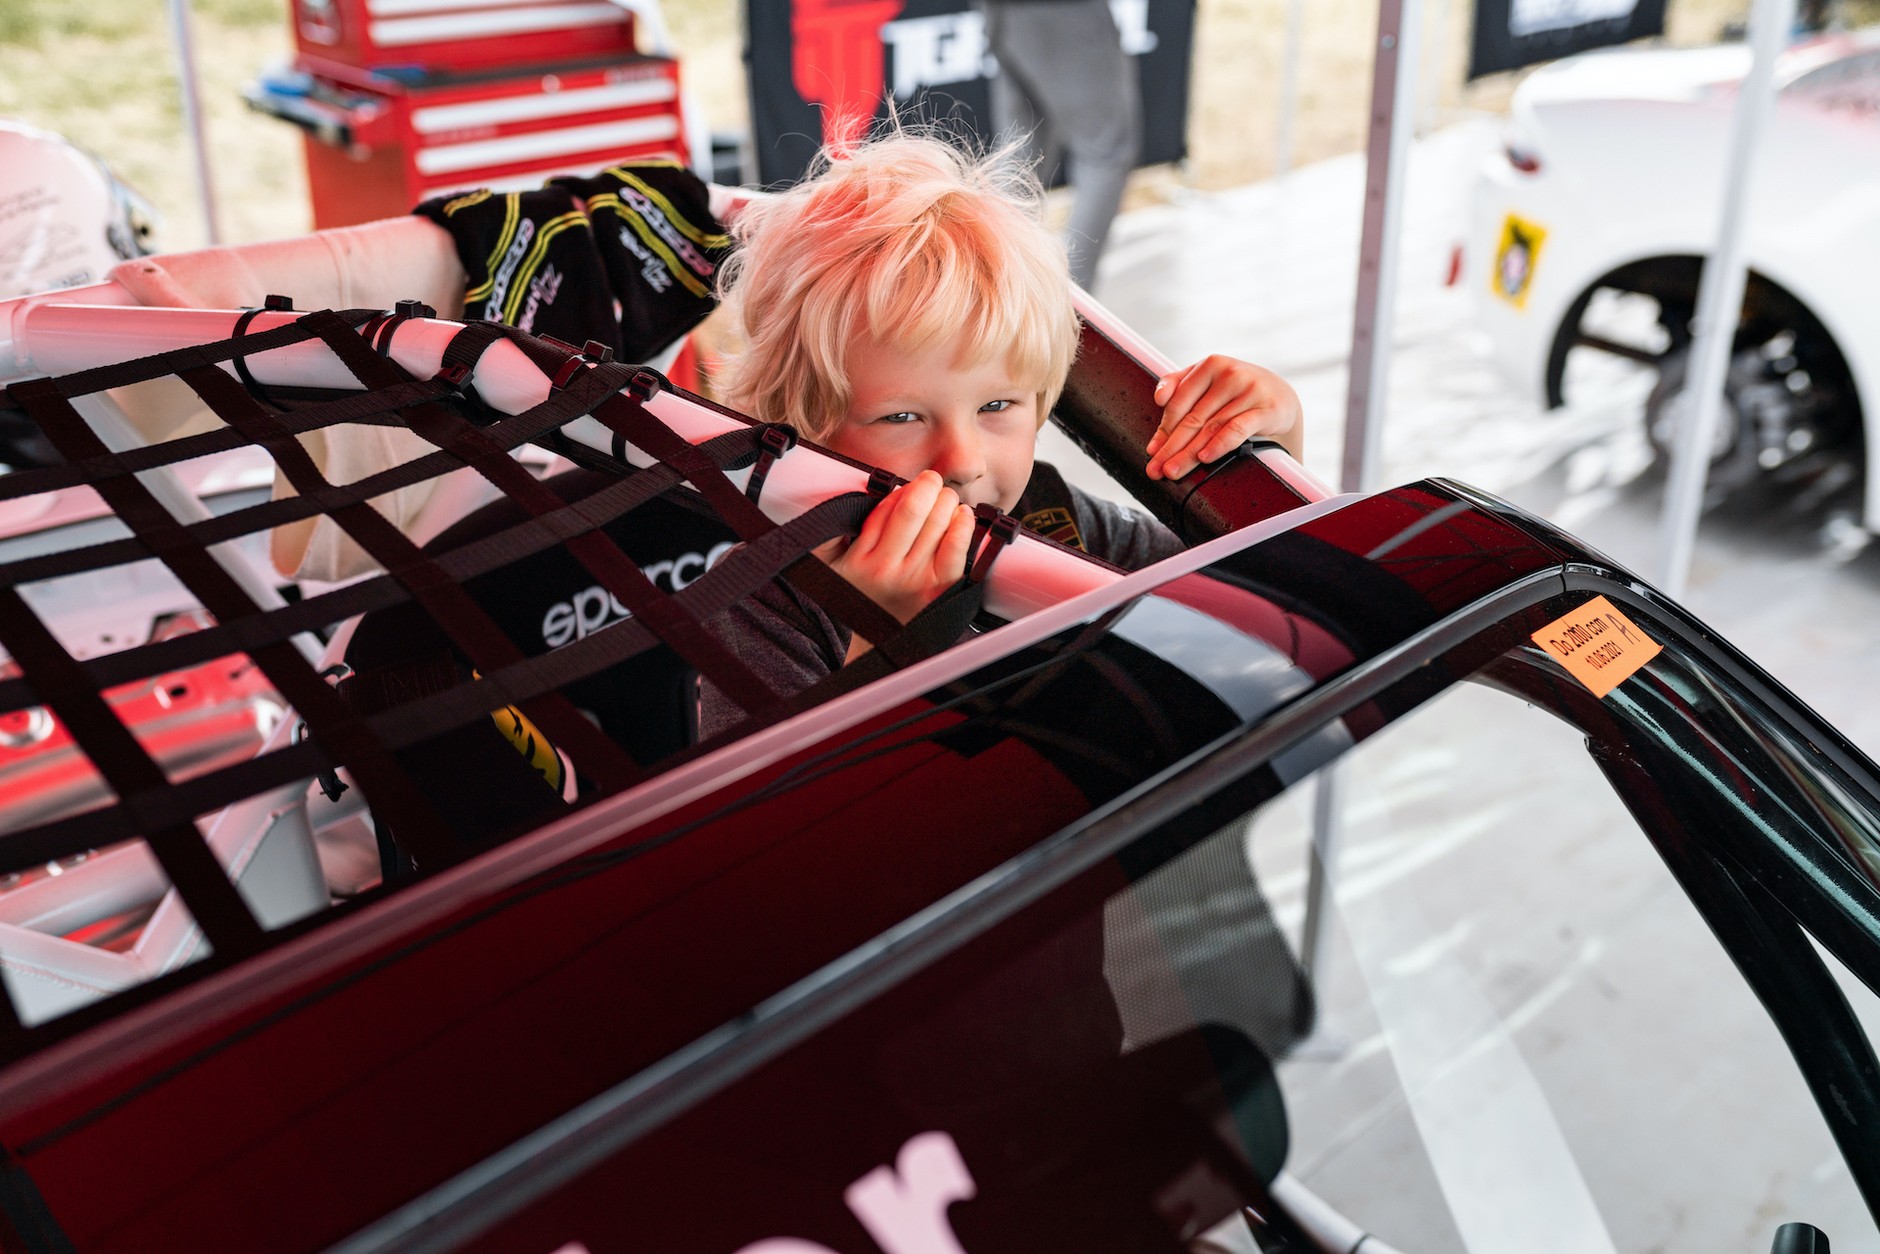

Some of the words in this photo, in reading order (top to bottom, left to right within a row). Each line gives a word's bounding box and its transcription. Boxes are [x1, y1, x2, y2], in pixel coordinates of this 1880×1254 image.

[1549, 638, 1575, 657] Do
[1562, 623, 1593, 648] 2000
[1585, 617, 1609, 636] ccm
[1584, 639, 1625, 671] 10.06.2021
